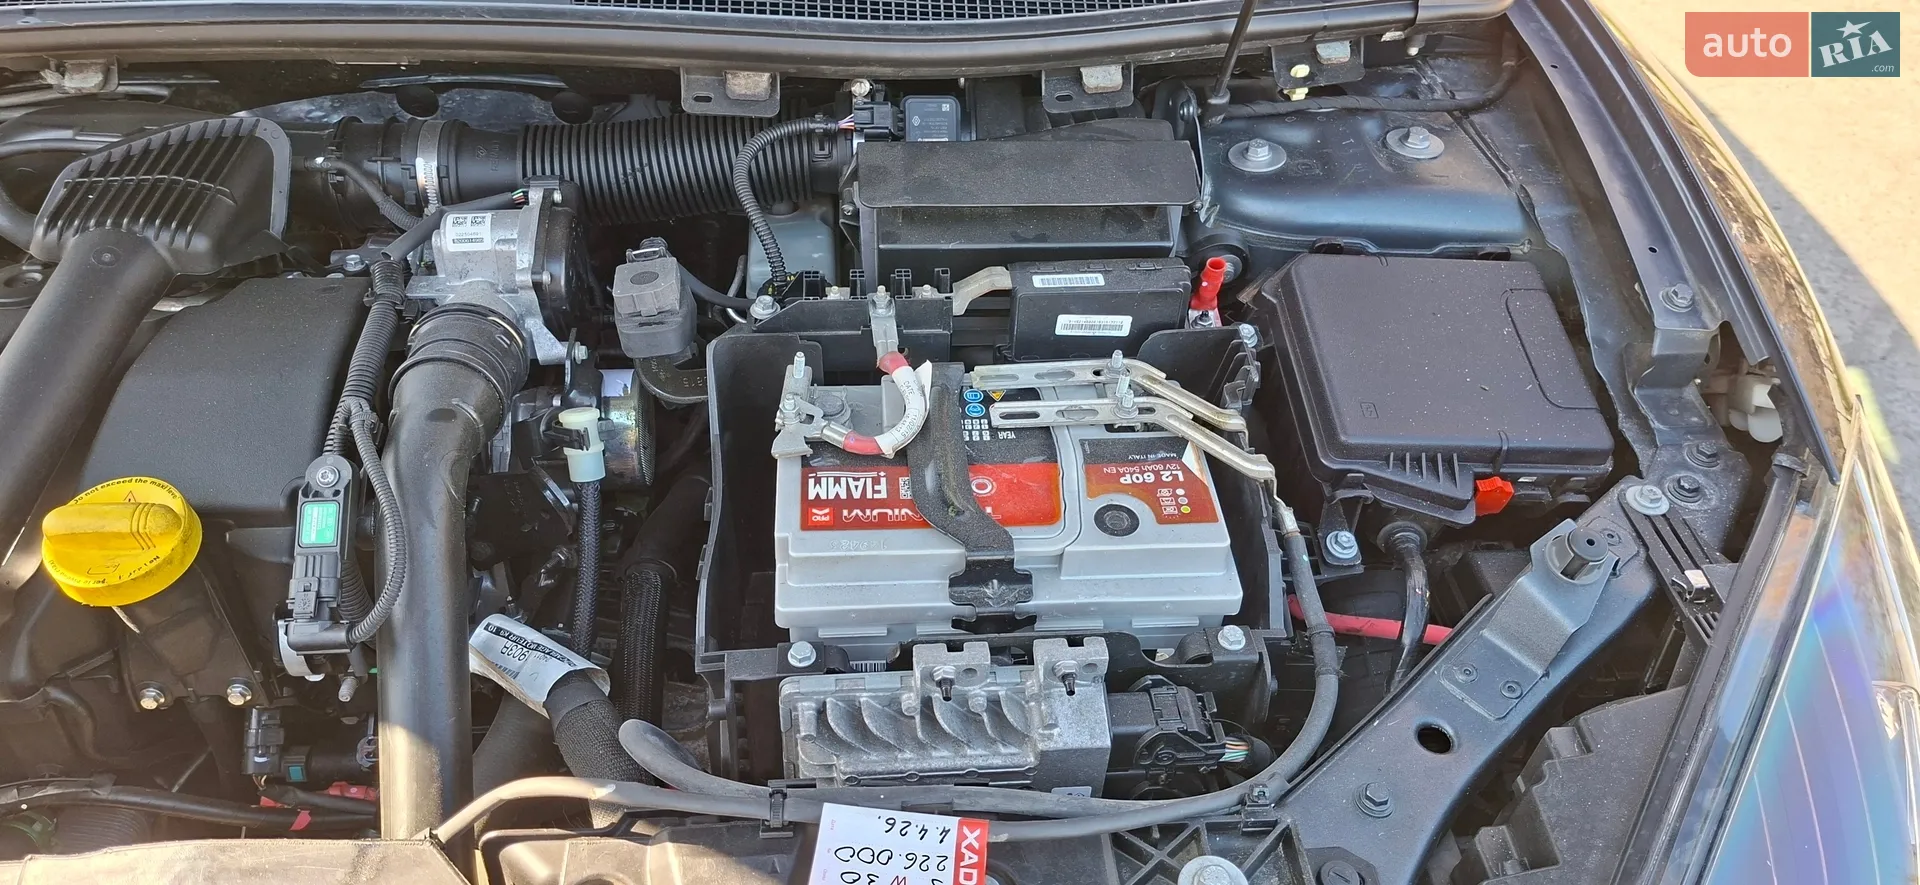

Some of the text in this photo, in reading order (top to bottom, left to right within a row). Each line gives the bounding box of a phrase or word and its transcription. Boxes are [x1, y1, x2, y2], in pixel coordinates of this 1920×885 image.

[998, 431, 1016, 440] YEAR
[1118, 465, 1139, 473] 540A
[1165, 463, 1180, 471] 12V
[1120, 470, 1185, 484] L2 60P
[85, 487, 99, 497] not
[100, 477, 134, 489] exceed
[808, 477, 888, 500] FIAMM
